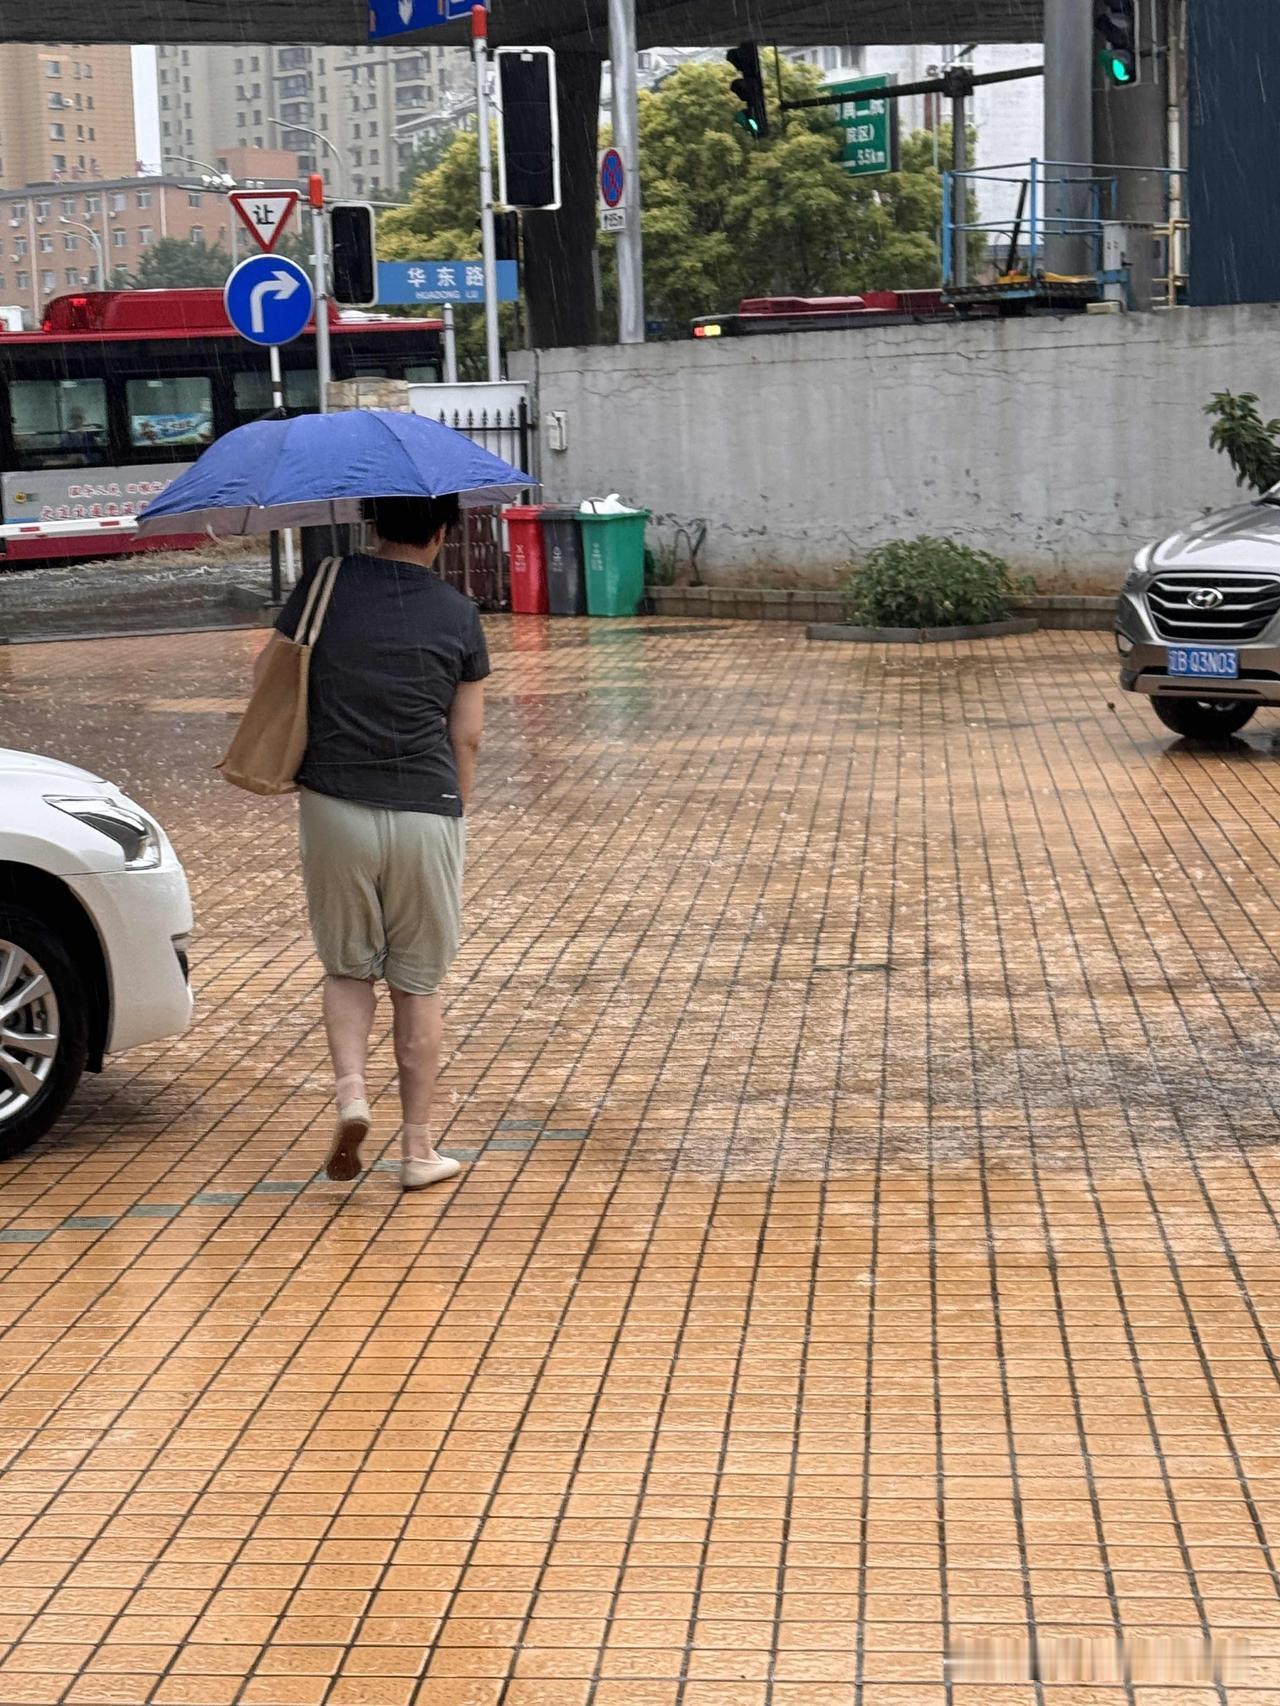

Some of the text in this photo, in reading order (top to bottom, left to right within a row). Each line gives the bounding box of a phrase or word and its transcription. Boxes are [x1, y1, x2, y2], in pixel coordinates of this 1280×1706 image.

[252, 204, 275, 225] 让
[407, 266, 485, 288] 华东路
[415, 290, 480, 300] HUADONG LU
